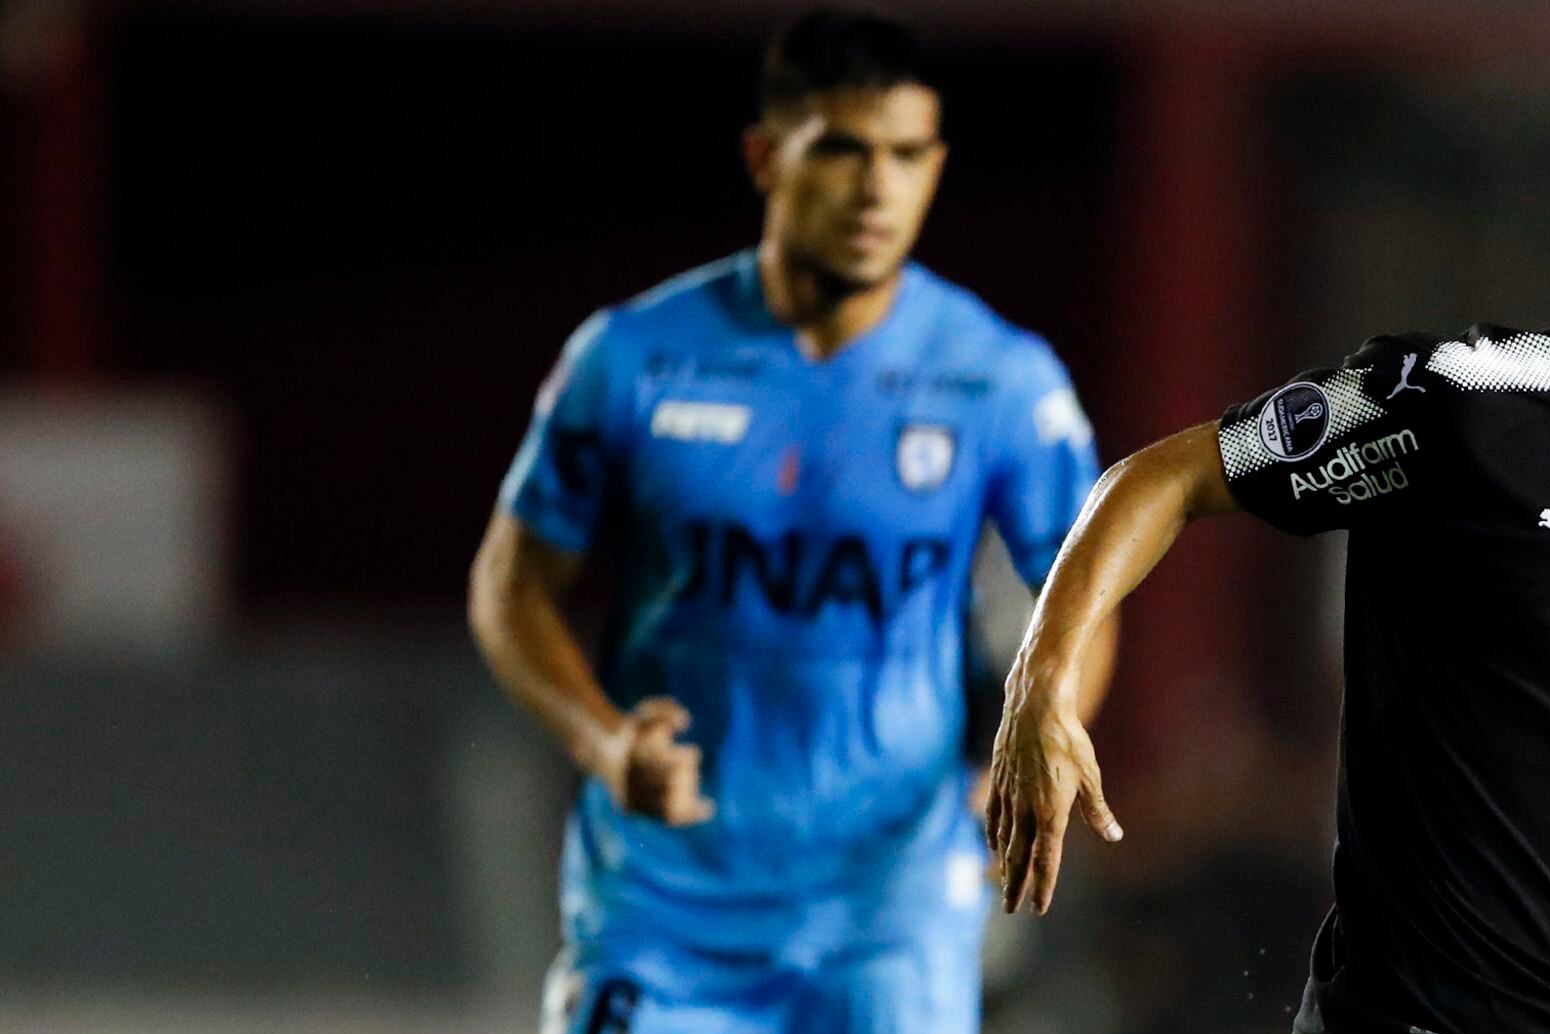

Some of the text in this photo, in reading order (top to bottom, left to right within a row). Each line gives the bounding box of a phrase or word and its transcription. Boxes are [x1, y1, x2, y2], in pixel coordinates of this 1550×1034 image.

[1265, 417, 1278, 441] 2017
[1289, 428, 1420, 500] Audifarm
[1327, 460, 1410, 505] salud
